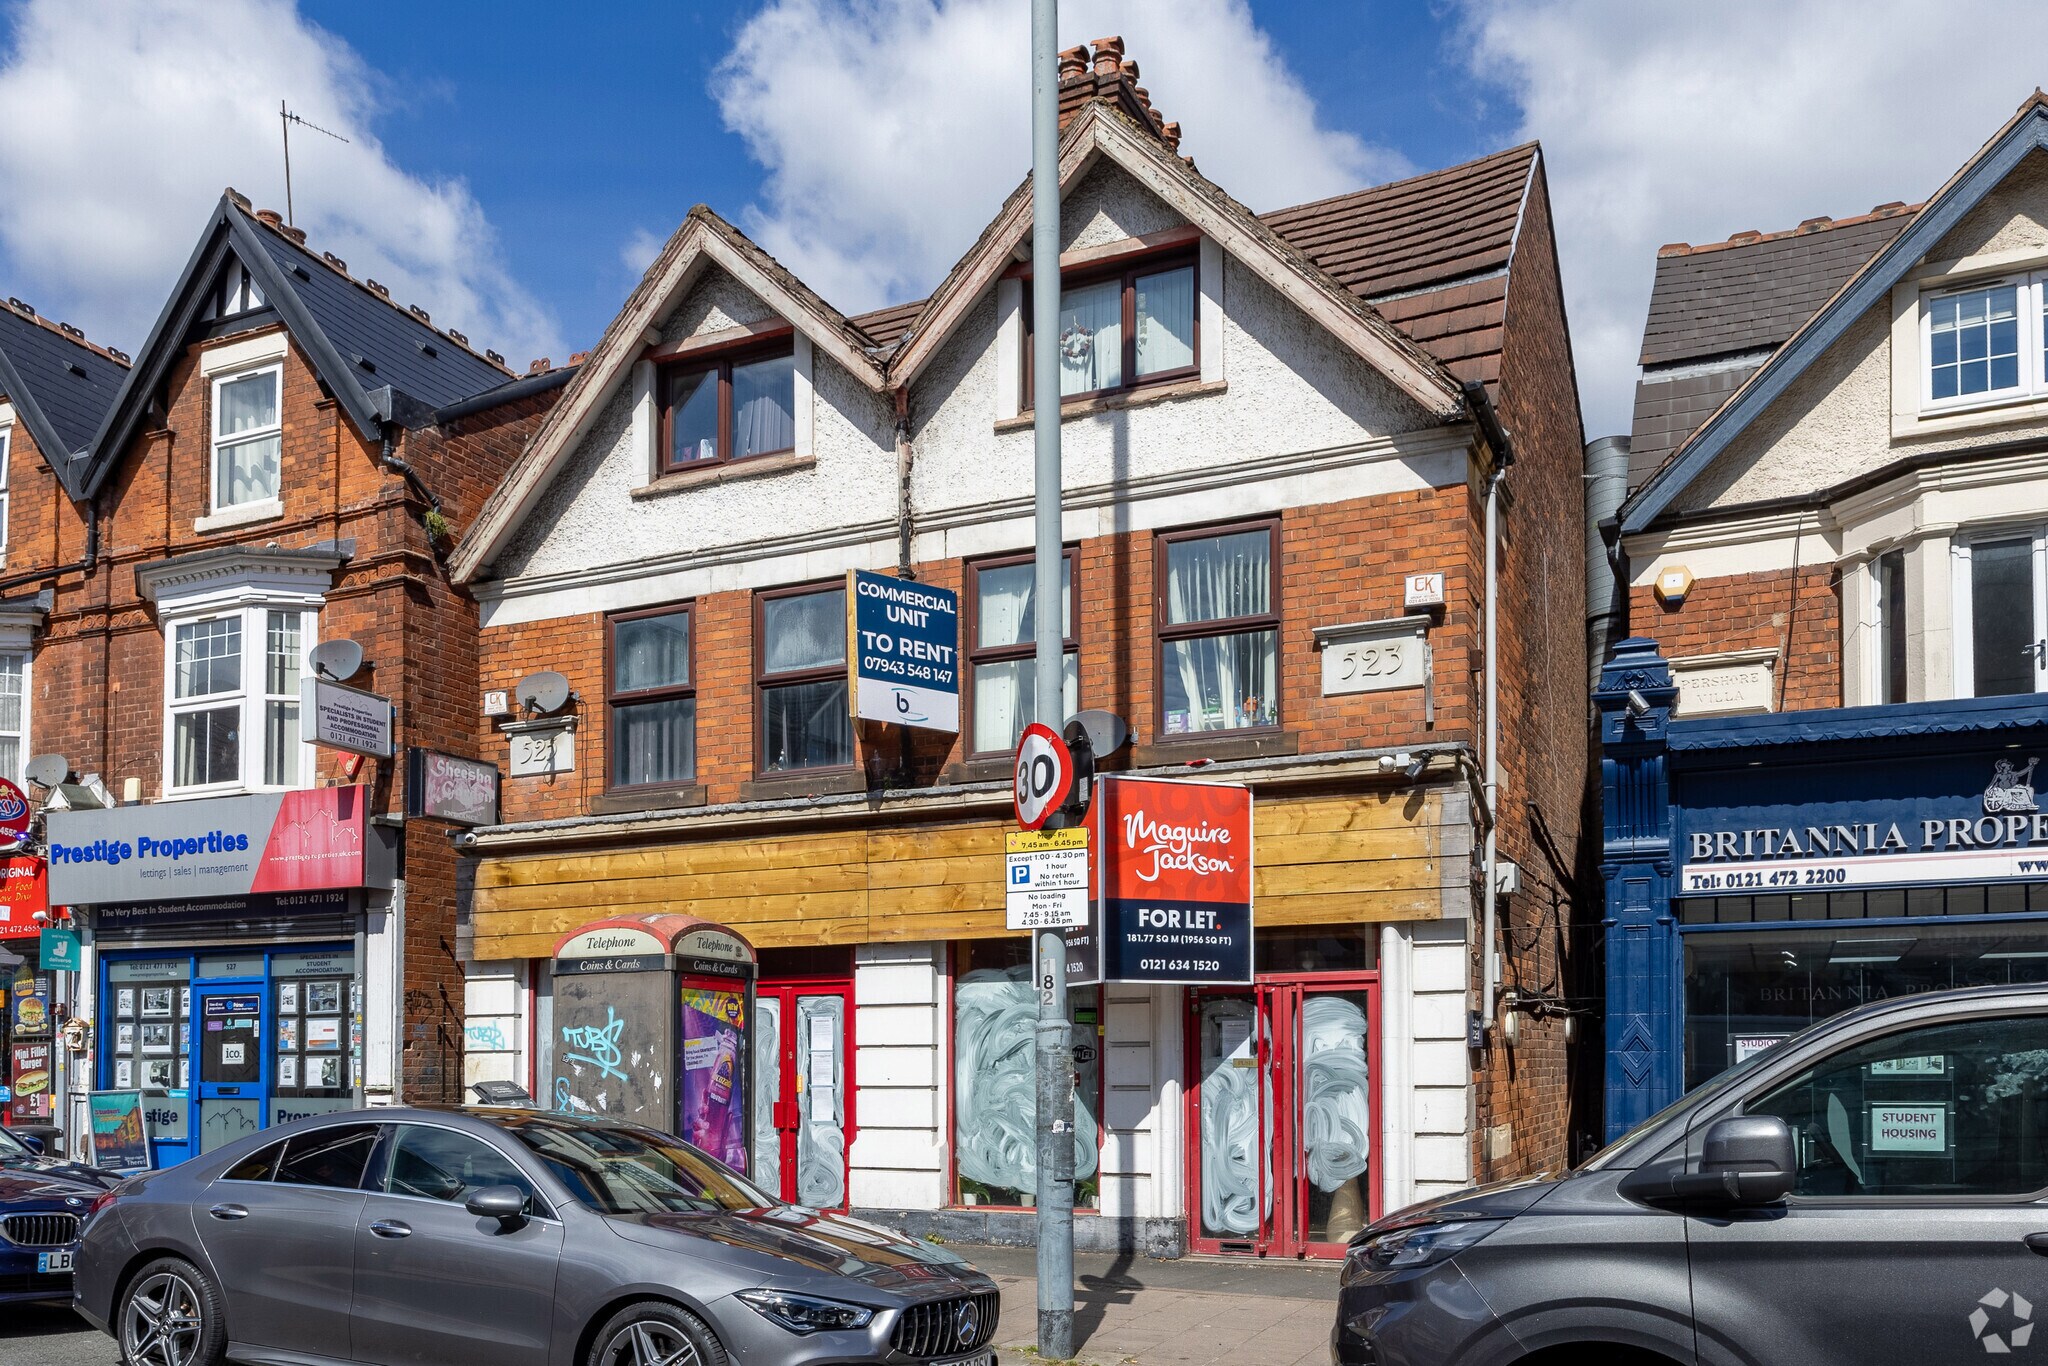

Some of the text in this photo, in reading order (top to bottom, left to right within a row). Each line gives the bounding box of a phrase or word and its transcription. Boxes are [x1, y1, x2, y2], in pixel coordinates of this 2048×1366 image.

[1415, 577, 1434, 593] CK
[858, 581, 956, 615] COMMERCIAL
[886, 604, 929, 628] UNIT
[862, 631, 952, 664] TO RENT
[864, 656, 952, 683] 07943 548 147
[1341, 645, 1403, 680] 523
[1682, 673, 1759, 689] PERSHORE
[490, 693, 502, 706] CK
[1697, 691, 1744, 703] VILLA
[320, 705, 355, 719] SPECIALISTS
[363, 717, 386, 727] STUDENT
[334, 703, 372, 717] Prestige Properties
[330, 723, 376, 739] ACCOMMODATION
[340, 718, 380, 733] PROFESSIONAL
[330, 732, 377, 749] 0121 471 1924
[431, 759, 492, 784] Sheesha
[1018, 754, 1055, 804] 30
[1123, 810, 1231, 854] Maguire
[1690, 813, 2048, 859] BRITANNIA PROPE
[50, 830, 249, 865] Prestige Properties
[1009, 855, 1032, 863] Except
[1074, 851, 1085, 859] pm
[1136, 842, 1234, 882] Jackson
[140, 863, 249, 880] lettings sales management
[1691, 868, 1846, 889] Tel: 0121 472 2200
[15, 881, 33, 891] Food
[275, 893, 344, 906] Tel: 0121 471 1924
[1040, 892, 1066, 900] loading
[102, 901, 246, 918] The Very Best In Student Accommodation
[1138, 909, 1222, 930] FOR LET.
[10, 925, 22, 933] 472
[587, 936, 636, 951] Telephone
[697, 937, 733, 953] Telephone
[1081, 936, 1089, 945] FT)
[1127, 934, 1232, 946] 181.77 SQ M (1956 SQ FT)
[165, 961, 178, 969] 1924
[580, 959, 640, 971] Coins & Cards
[694, 960, 738, 975] Coins & Cards
[1071, 962, 1084, 973] 1520
[1140, 959, 1219, 971] 0121 634 1520
[1760, 984, 1888, 1001] BRITANNIA
[15, 1046, 47, 1060] Mini Fillet
[226, 1048, 242, 1059] ico.
[21, 1059, 42, 1069] Burger
[1882, 1113, 1936, 1123] STUDENT
[1882, 1129, 1937, 1138] HOUSING
